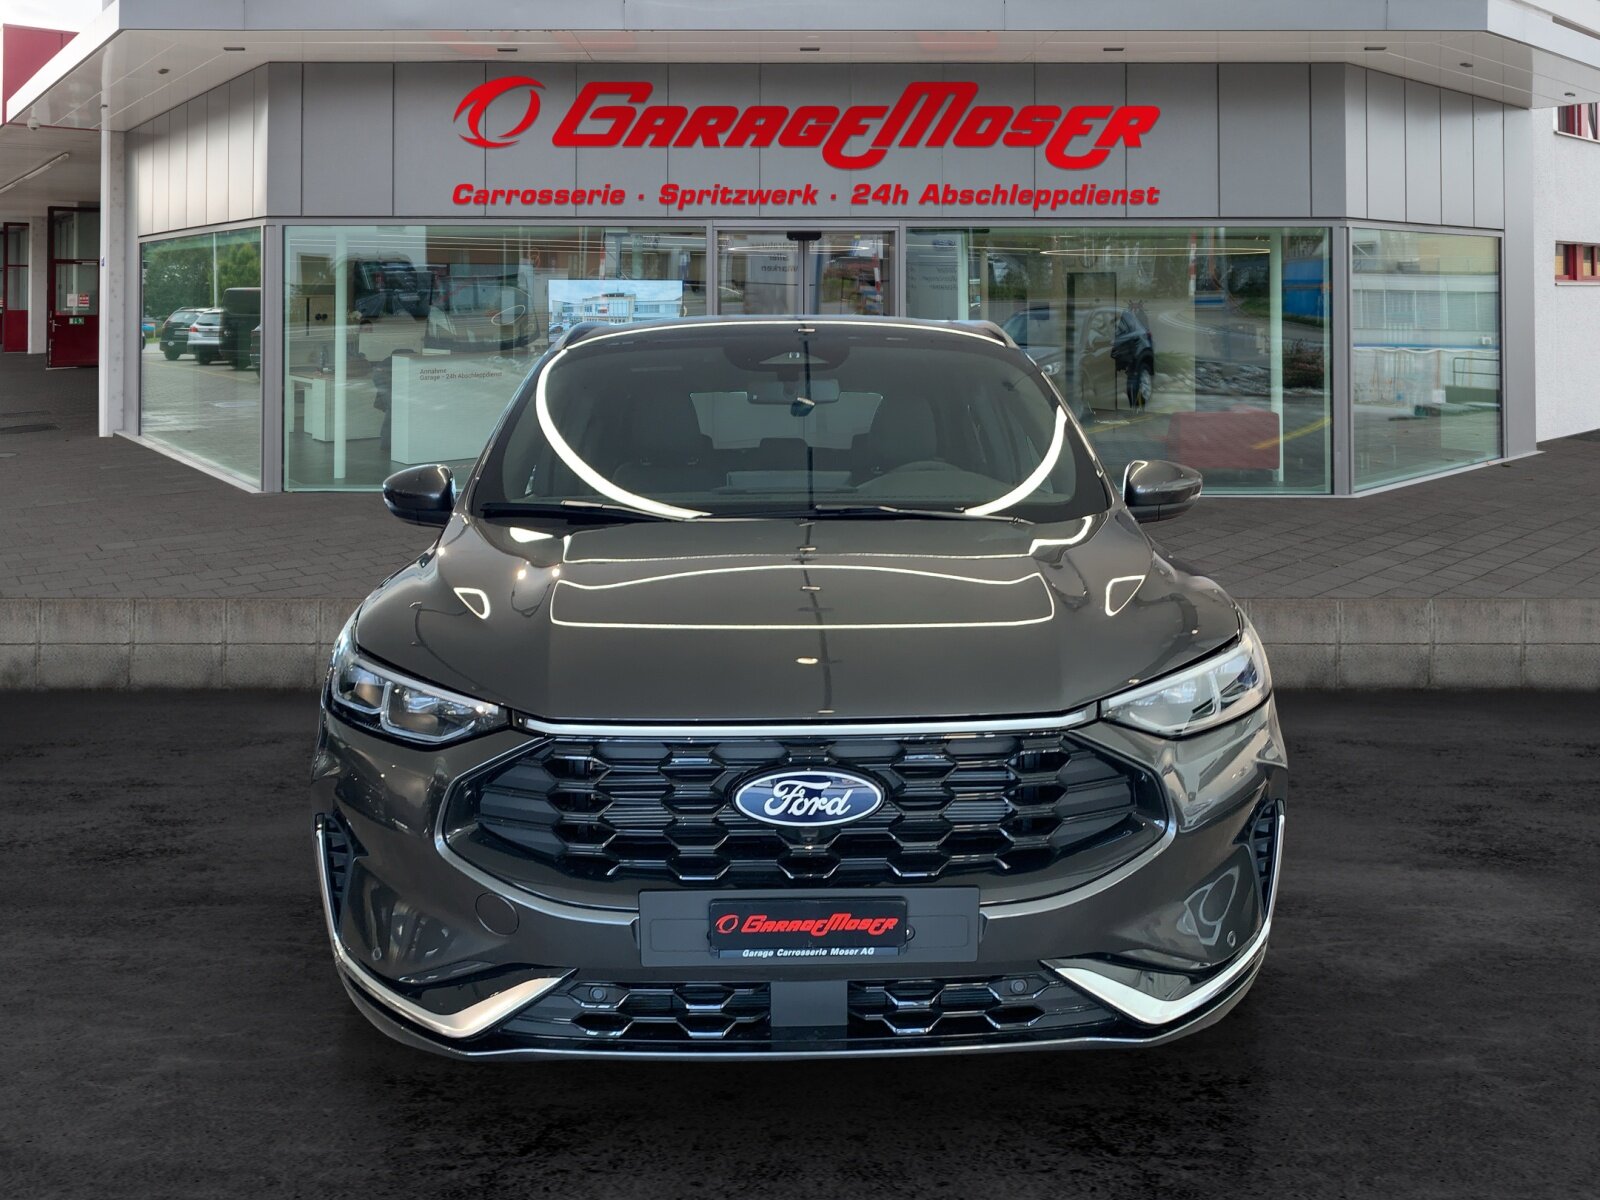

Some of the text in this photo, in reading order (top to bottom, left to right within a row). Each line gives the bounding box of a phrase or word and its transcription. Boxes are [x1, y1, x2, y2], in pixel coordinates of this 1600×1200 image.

[452, 183, 626, 205] Carrosserie
[658, 183, 819, 211] Spritzwerk
[851, 183, 909, 205] 24h
[919, 183, 1161, 211] Abschleppdienst
[764, 779, 853, 817] Ford
[742, 947, 875, 958] Garage Carrosserie Moser AG
